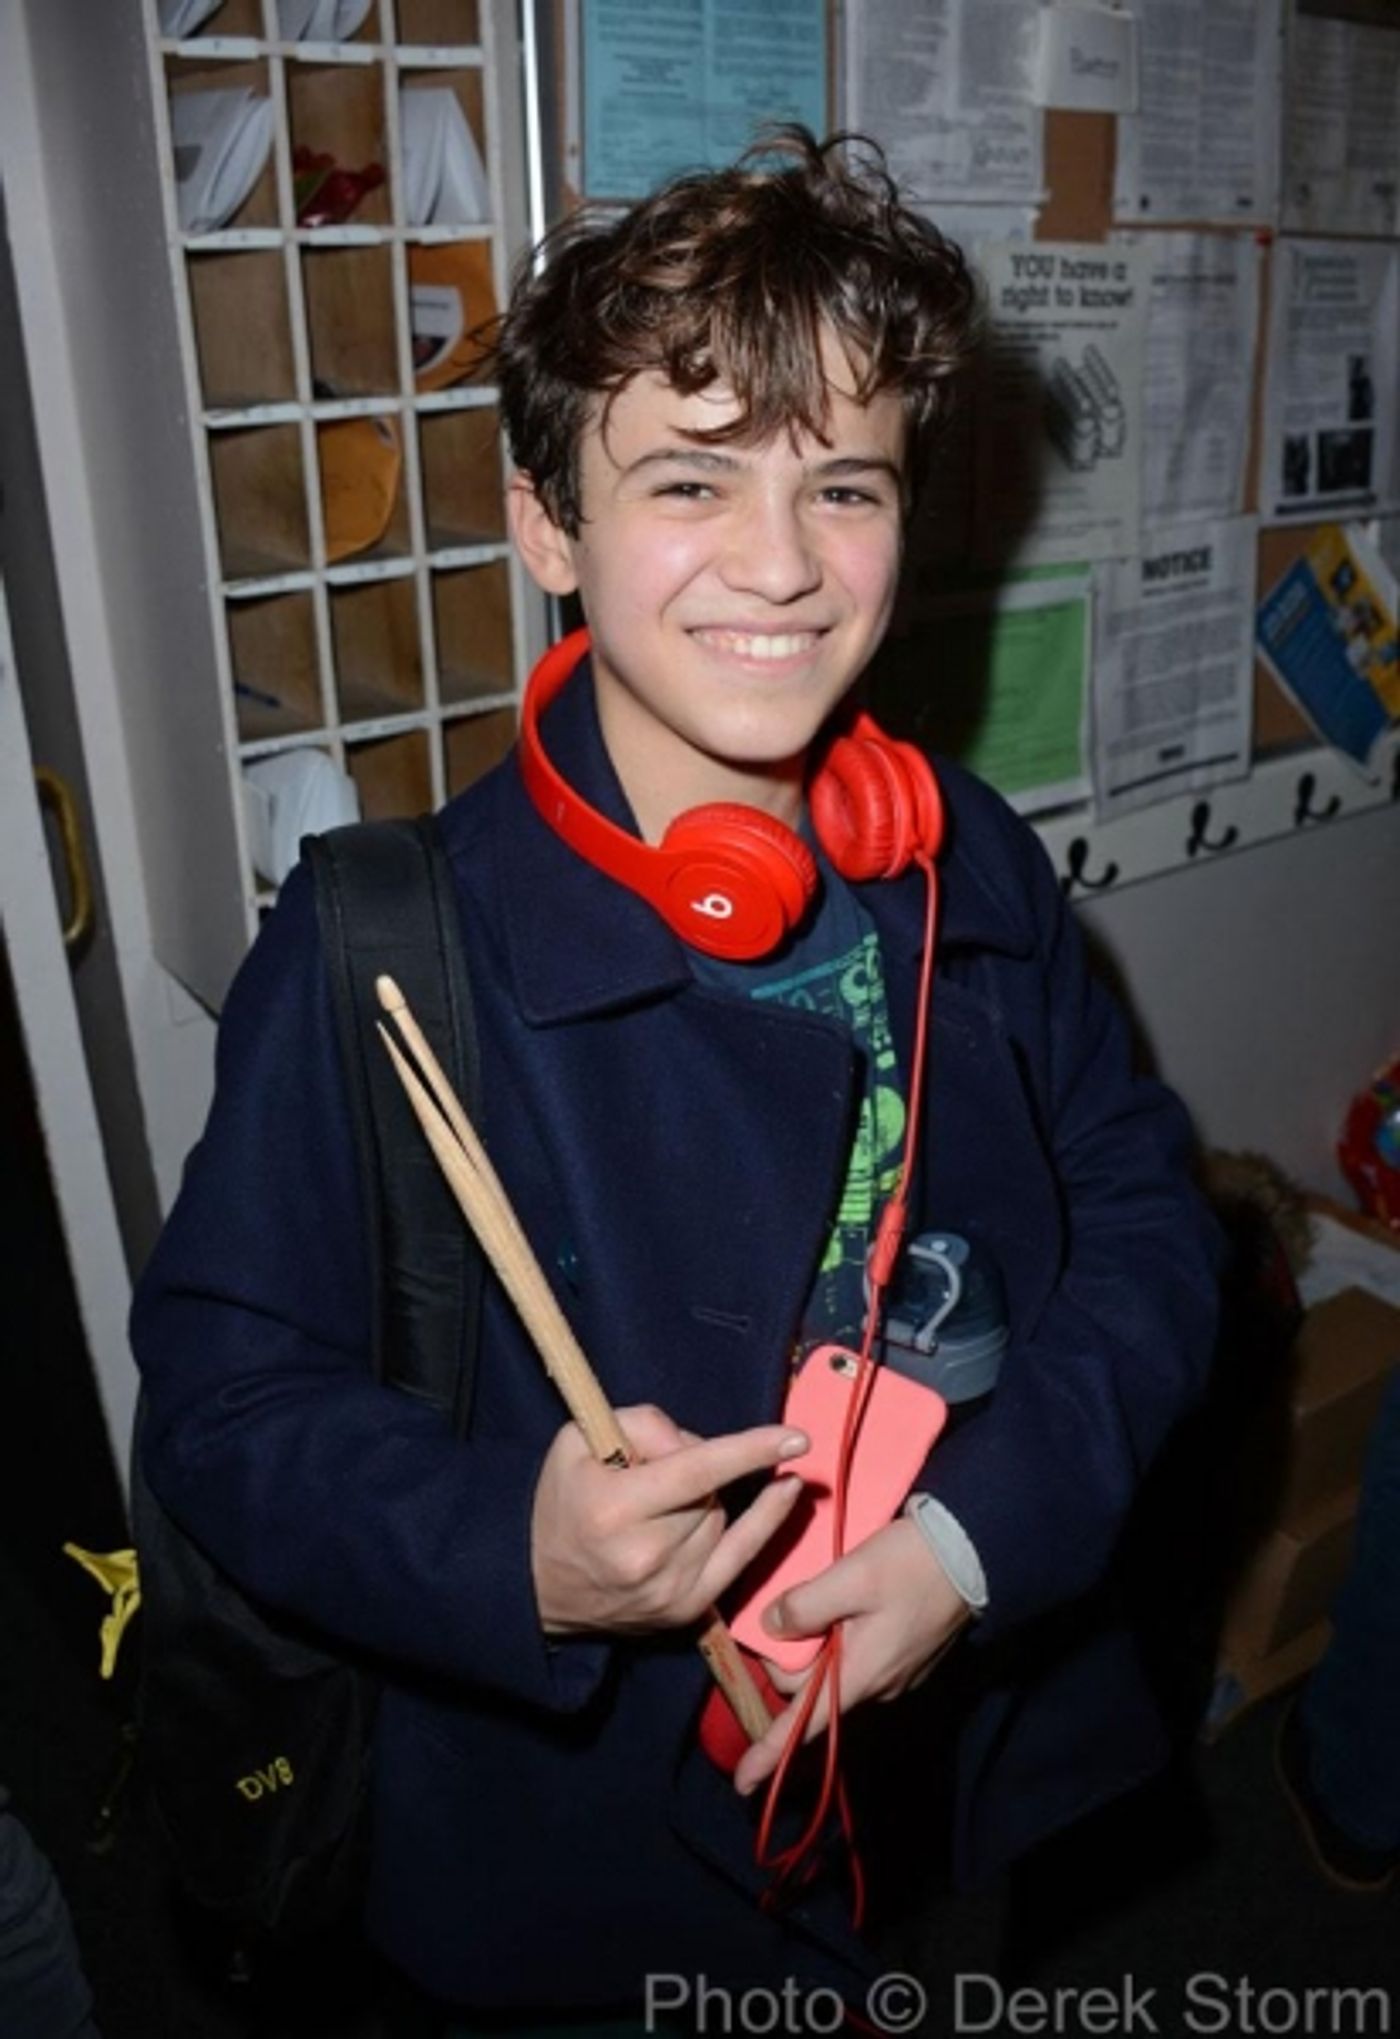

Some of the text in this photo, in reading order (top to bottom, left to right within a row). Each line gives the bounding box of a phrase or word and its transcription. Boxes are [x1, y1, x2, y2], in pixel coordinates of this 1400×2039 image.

[1011, 254, 1054, 279] YOU
[1061, 256, 1108, 280] have
[1113, 261, 1127, 282] a
[1001, 285, 1049, 313] right
[1055, 286, 1074, 307] to
[1141, 546, 1212, 582] NOTICE
